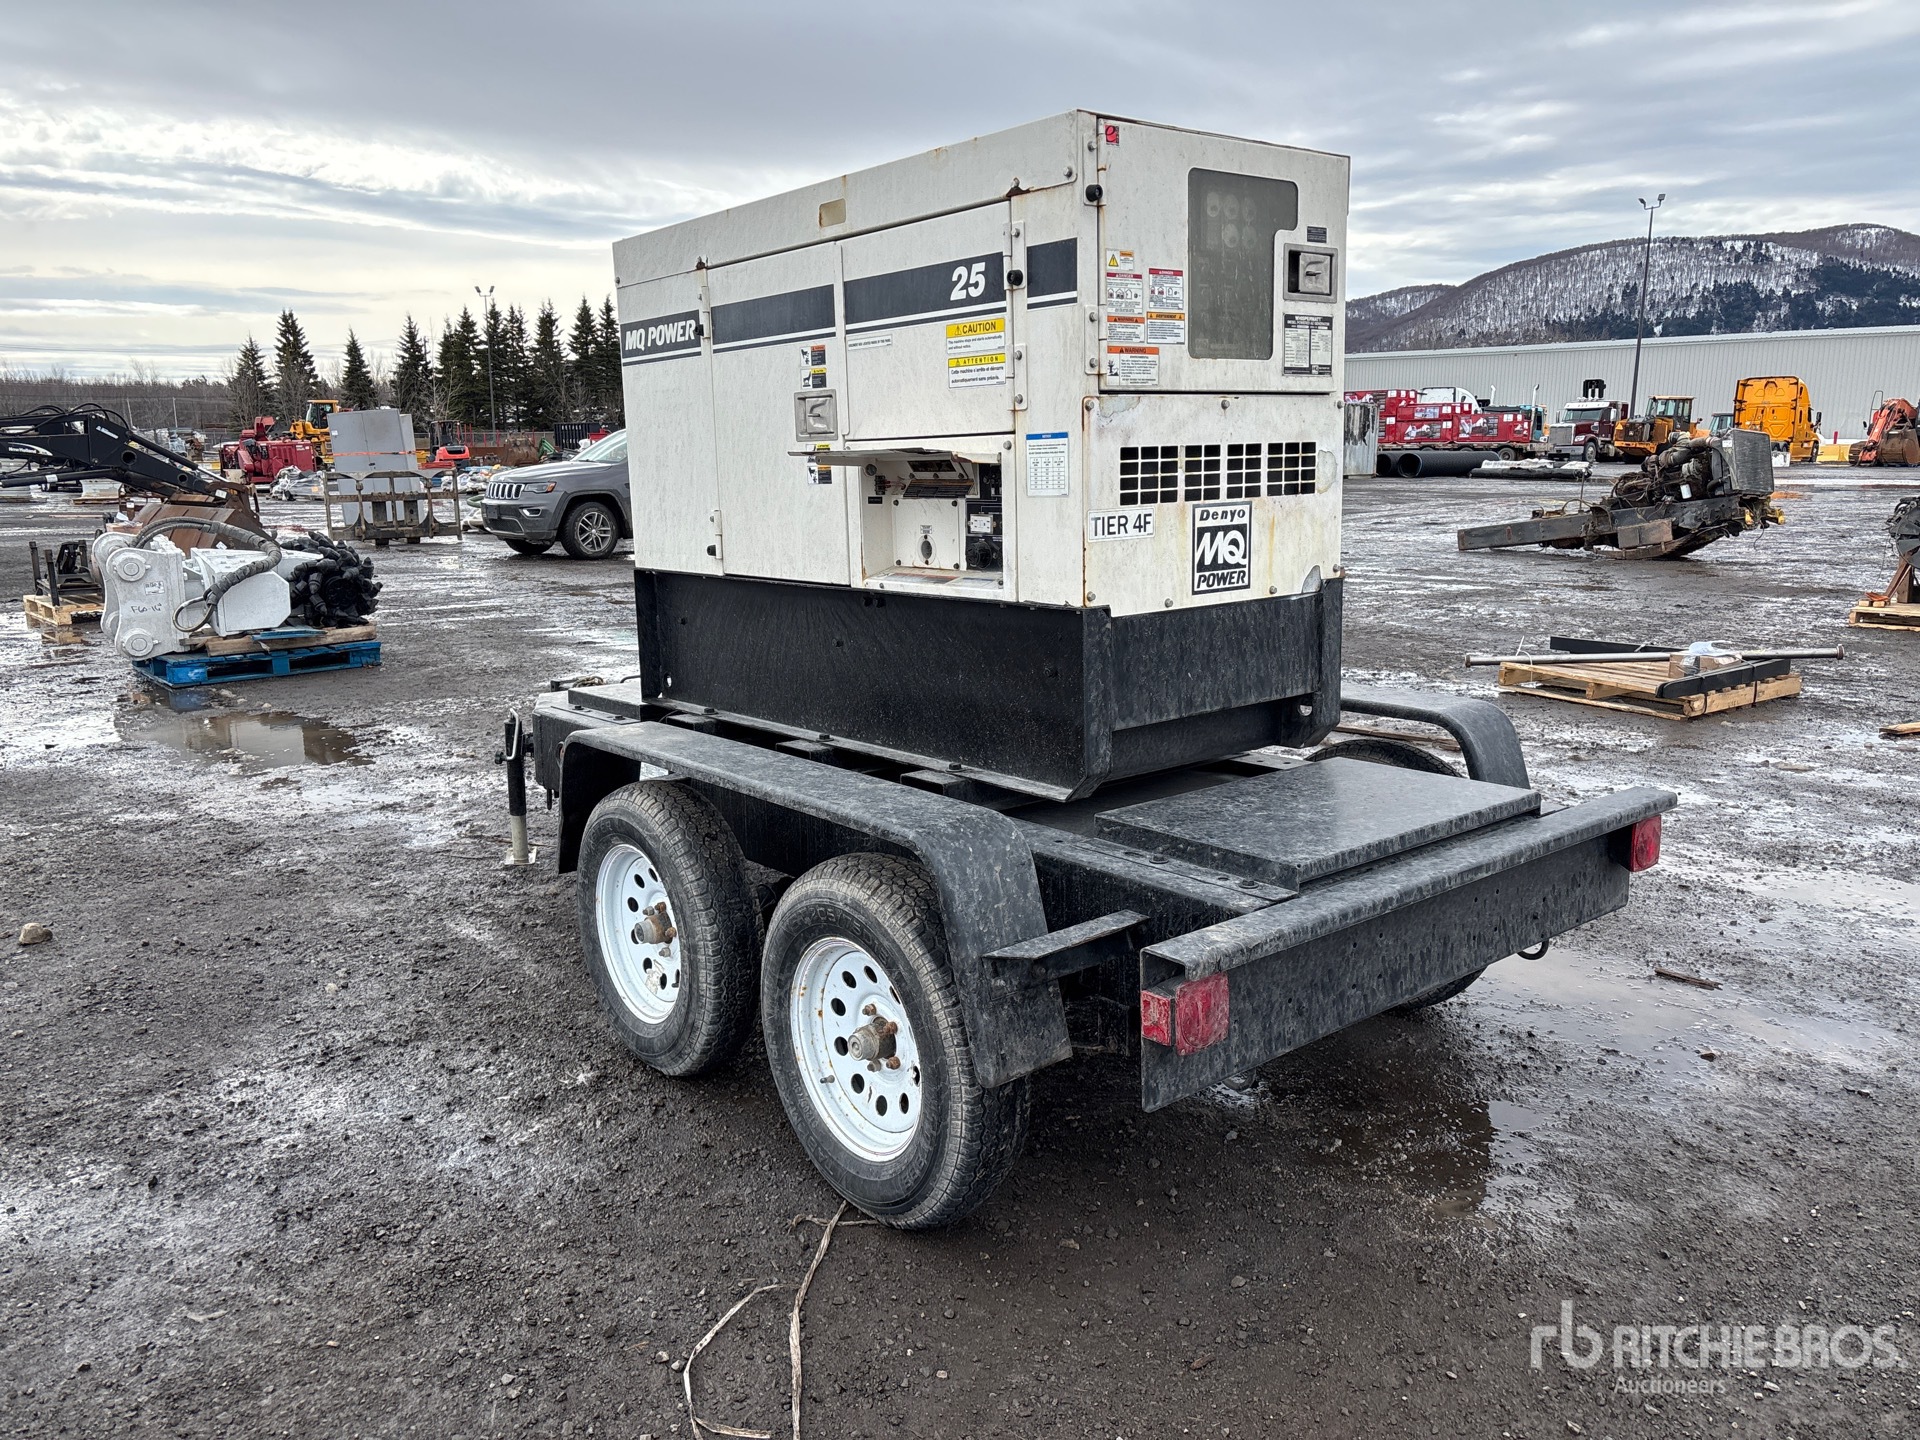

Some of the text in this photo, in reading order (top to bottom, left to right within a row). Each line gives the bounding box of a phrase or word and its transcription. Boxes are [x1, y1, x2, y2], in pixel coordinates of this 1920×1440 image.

[950, 262, 986, 301] 25
[625, 319, 696, 352] MQ POWER
[962, 321, 996, 334] CAUTION
[962, 356, 999, 365] ATTENTION
[1091, 513, 1153, 537] TIER 4F
[1199, 508, 1246, 522] Denyo
[1196, 530, 1247, 566] MQ
[1196, 569, 1246, 589] POWER
